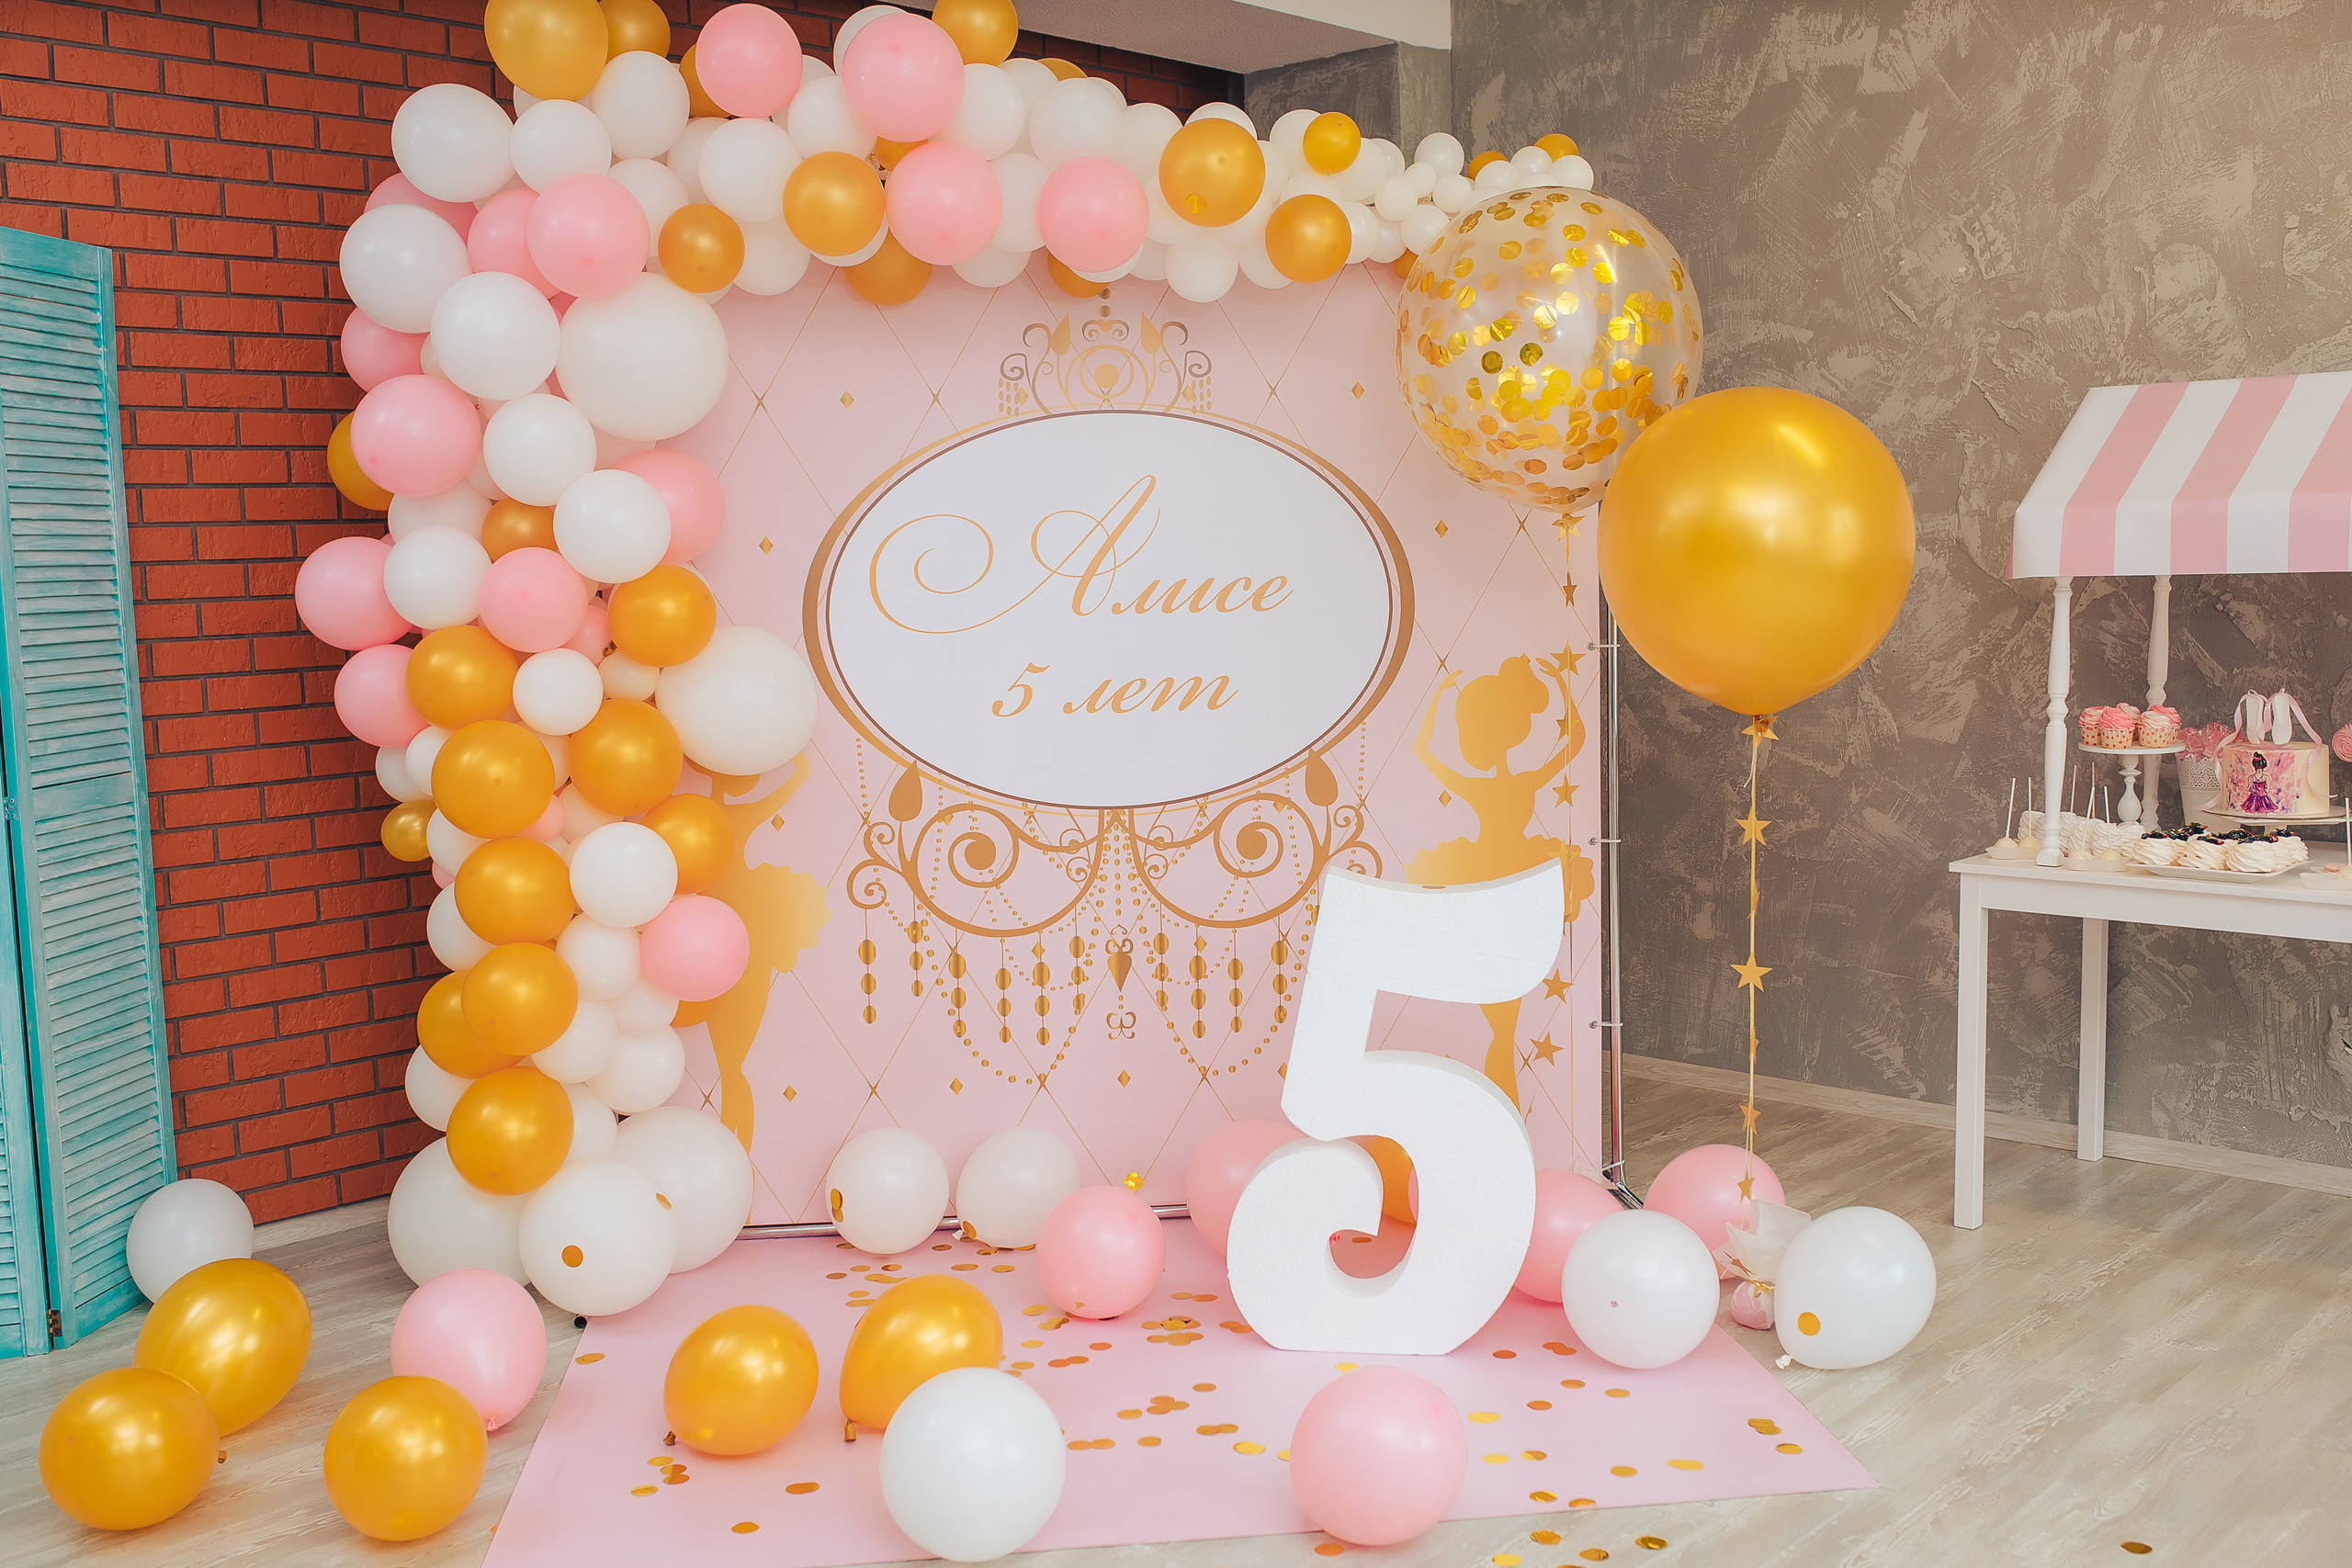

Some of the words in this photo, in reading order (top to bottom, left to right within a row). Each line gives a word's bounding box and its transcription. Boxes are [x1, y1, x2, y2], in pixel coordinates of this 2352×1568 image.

[869, 475, 1294, 634] Алисе
[991, 662, 1050, 717] 5
[1063, 675, 1239, 715] лет
[1227, 857, 1565, 1355] 5
